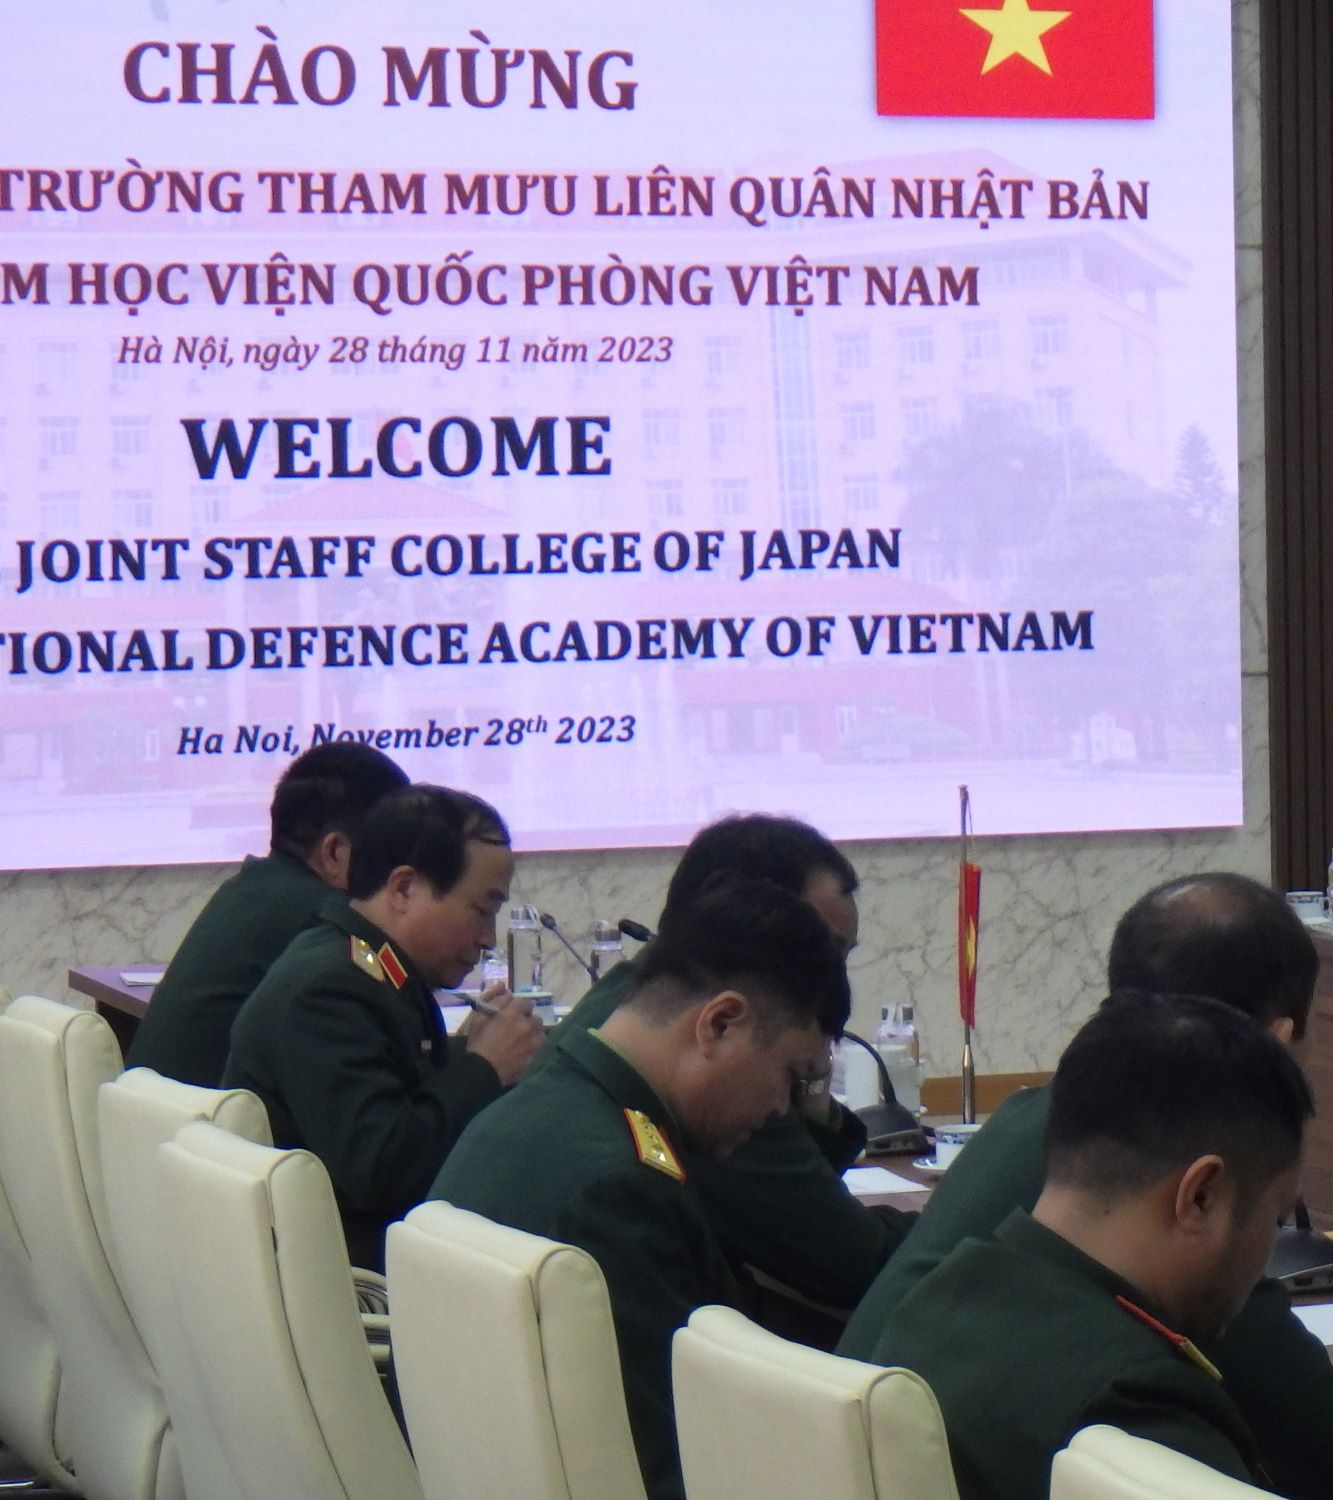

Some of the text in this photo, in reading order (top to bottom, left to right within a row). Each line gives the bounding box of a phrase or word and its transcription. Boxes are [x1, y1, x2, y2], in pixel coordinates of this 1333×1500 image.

[123, 25, 639, 111] CHÀO MỪNG
[0, 158, 1149, 230] TRƯỜNG THAM MƯU LIÊN QUÂN NHẬT BẢN
[67, 262, 189, 317] HỌC
[200, 251, 337, 317] VIỆN
[352, 250, 508, 317] QUỐC
[521, 253, 713, 307] PHÒNG
[725, 254, 851, 317] VIỆT
[863, 265, 980, 307] NAM
[117, 335, 674, 372] Hà Nội, ngày 28 tháng 11 năm 2023
[179, 415, 612, 480] WELCOME
[16, 527, 902, 594] JOINT STAFF COLLEGE OF JAPAN
[0, 610, 1095, 676] IONAL DEFENCE ACADEMY OF VIETNAM
[176, 726, 225, 756] Ha
[233, 724, 300, 757] Noi,
[483, 715, 548, 746] 28th
[554, 714, 636, 744] 2023
